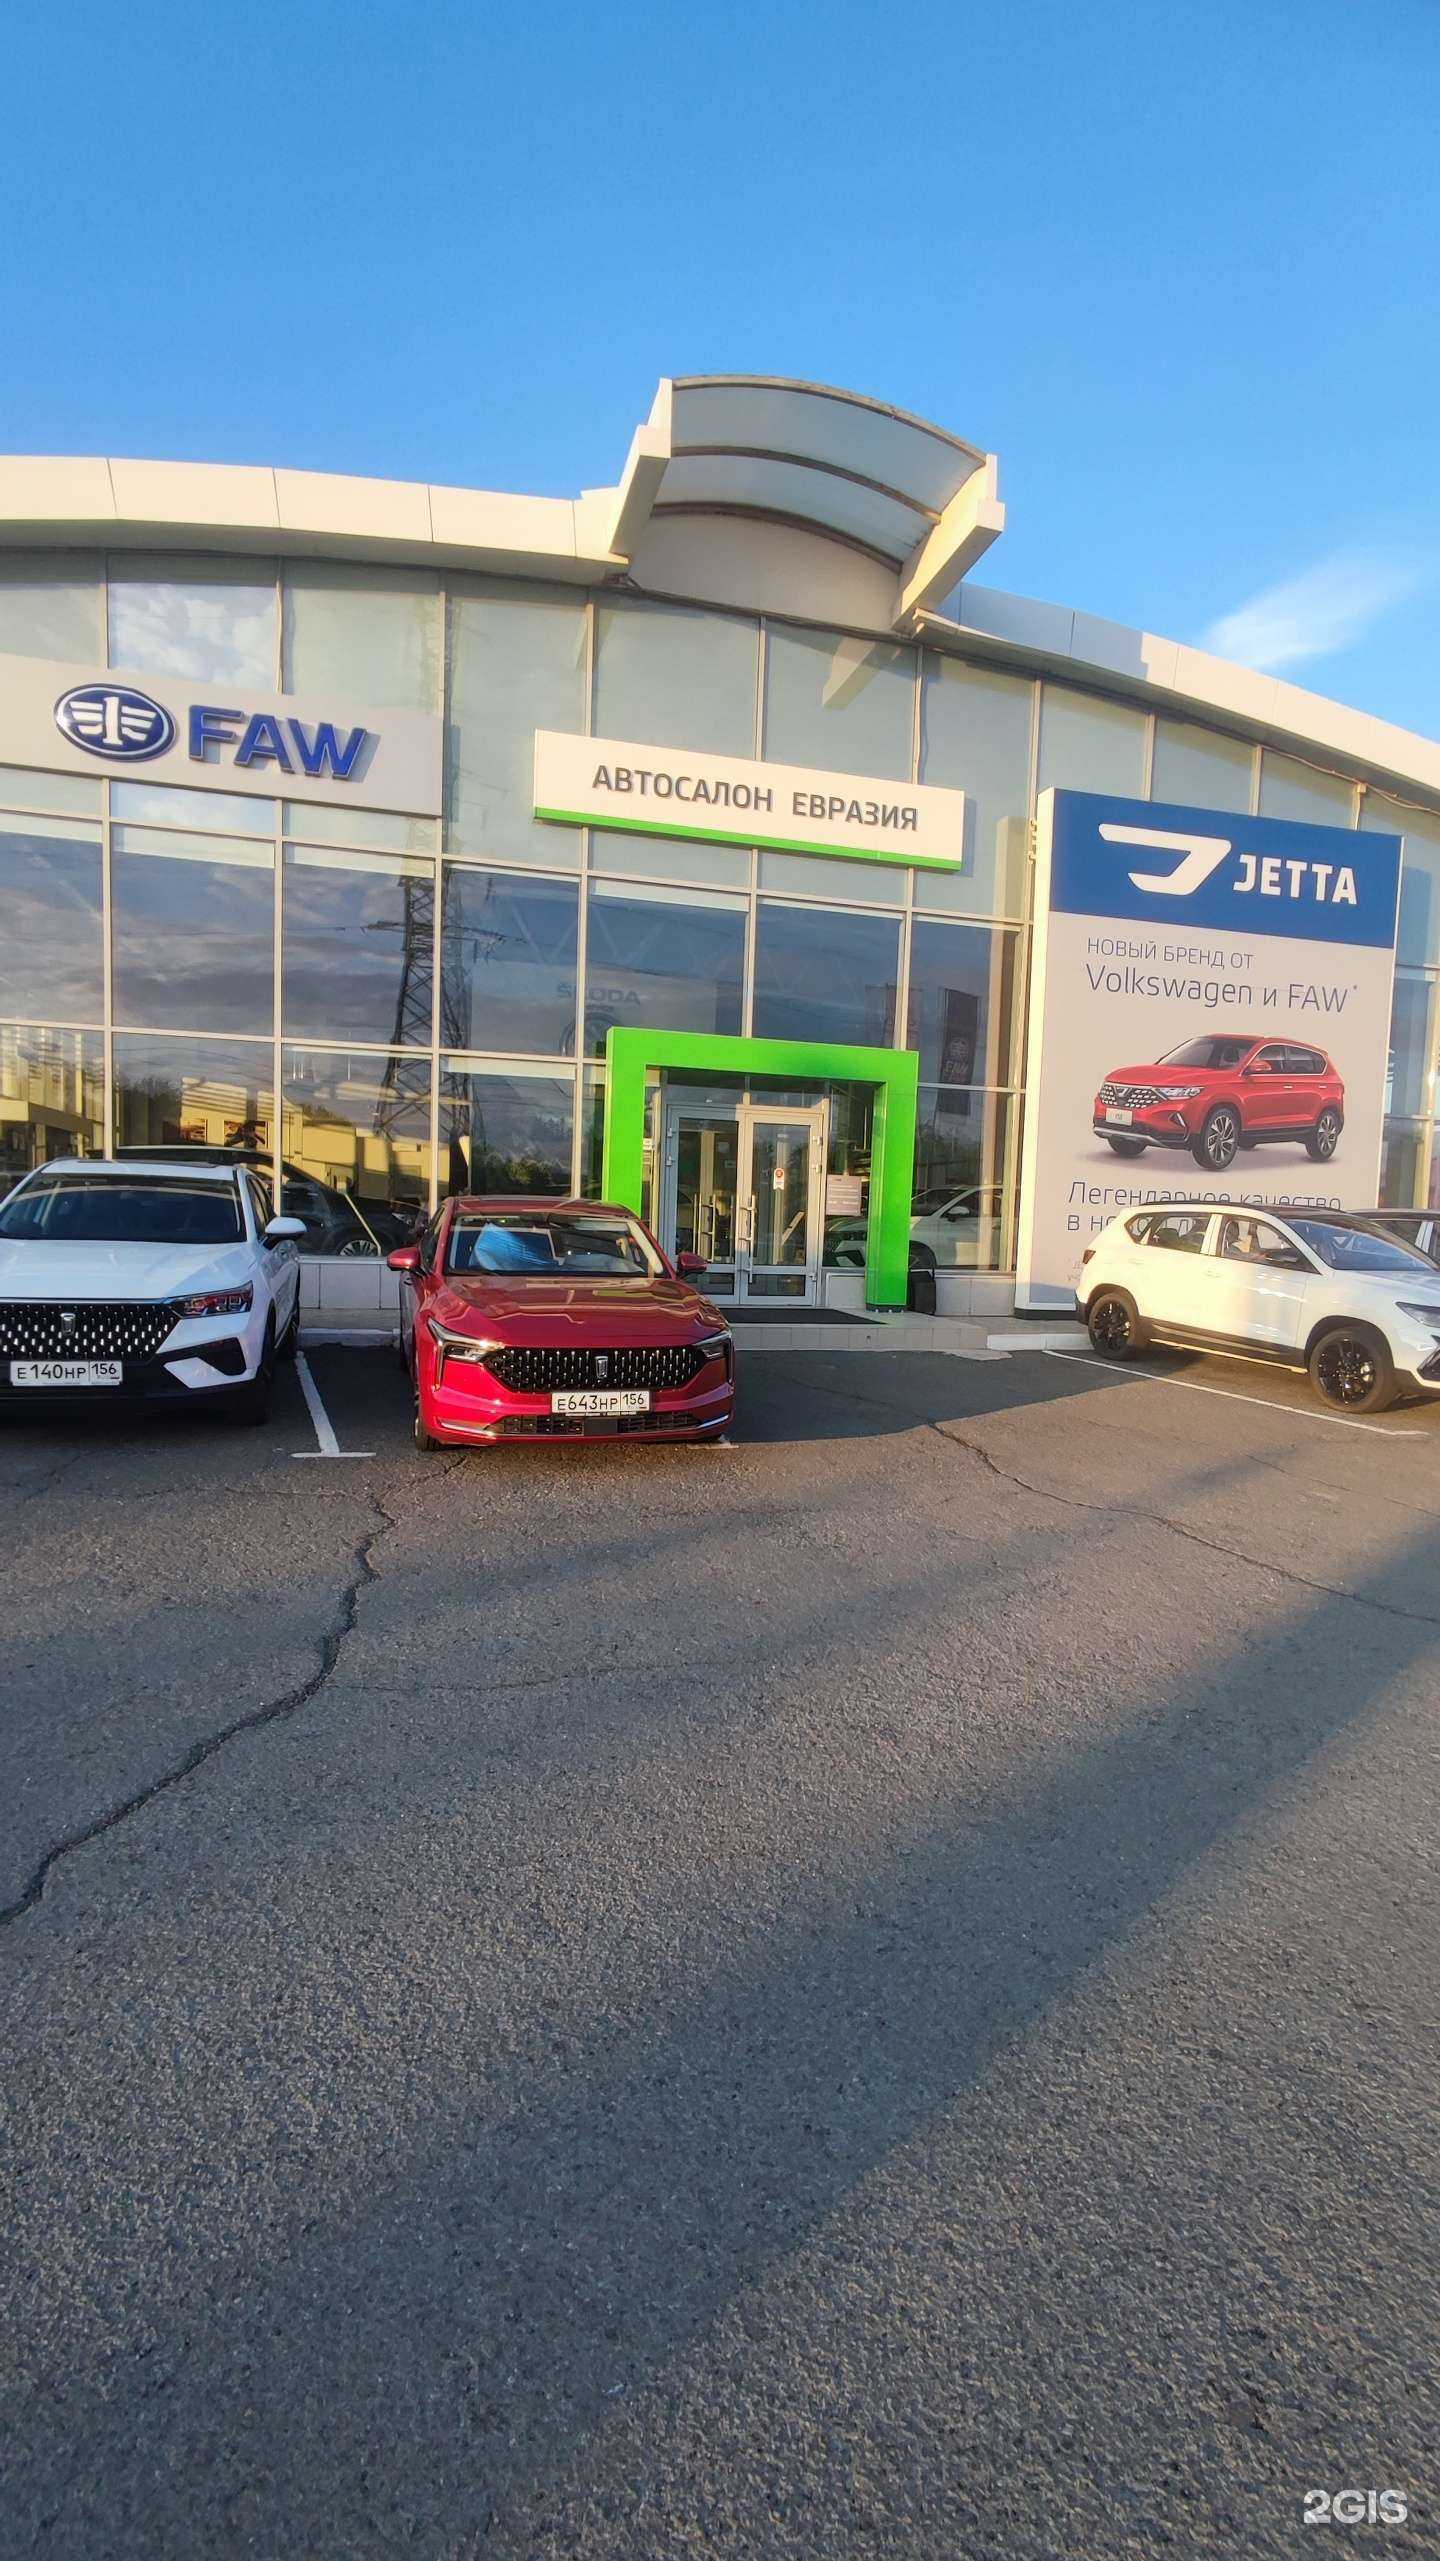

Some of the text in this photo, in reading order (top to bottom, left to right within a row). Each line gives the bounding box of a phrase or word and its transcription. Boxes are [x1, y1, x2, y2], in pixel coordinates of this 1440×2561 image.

[189, 704, 367, 778] FAW
[592, 764, 919, 832] АВТОСАЛОН ЕВРАЗИЯ
[1232, 854, 1358, 905] JETTA
[1087, 937, 1254, 970] НОВЫЙ БРЕНД ОТ
[1086, 963, 1252, 1008] Volkswagen
[1263, 987, 1277, 1006] и
[91, 1363, 117, 1375] 156
[622, 1393, 645, 1405] 156
